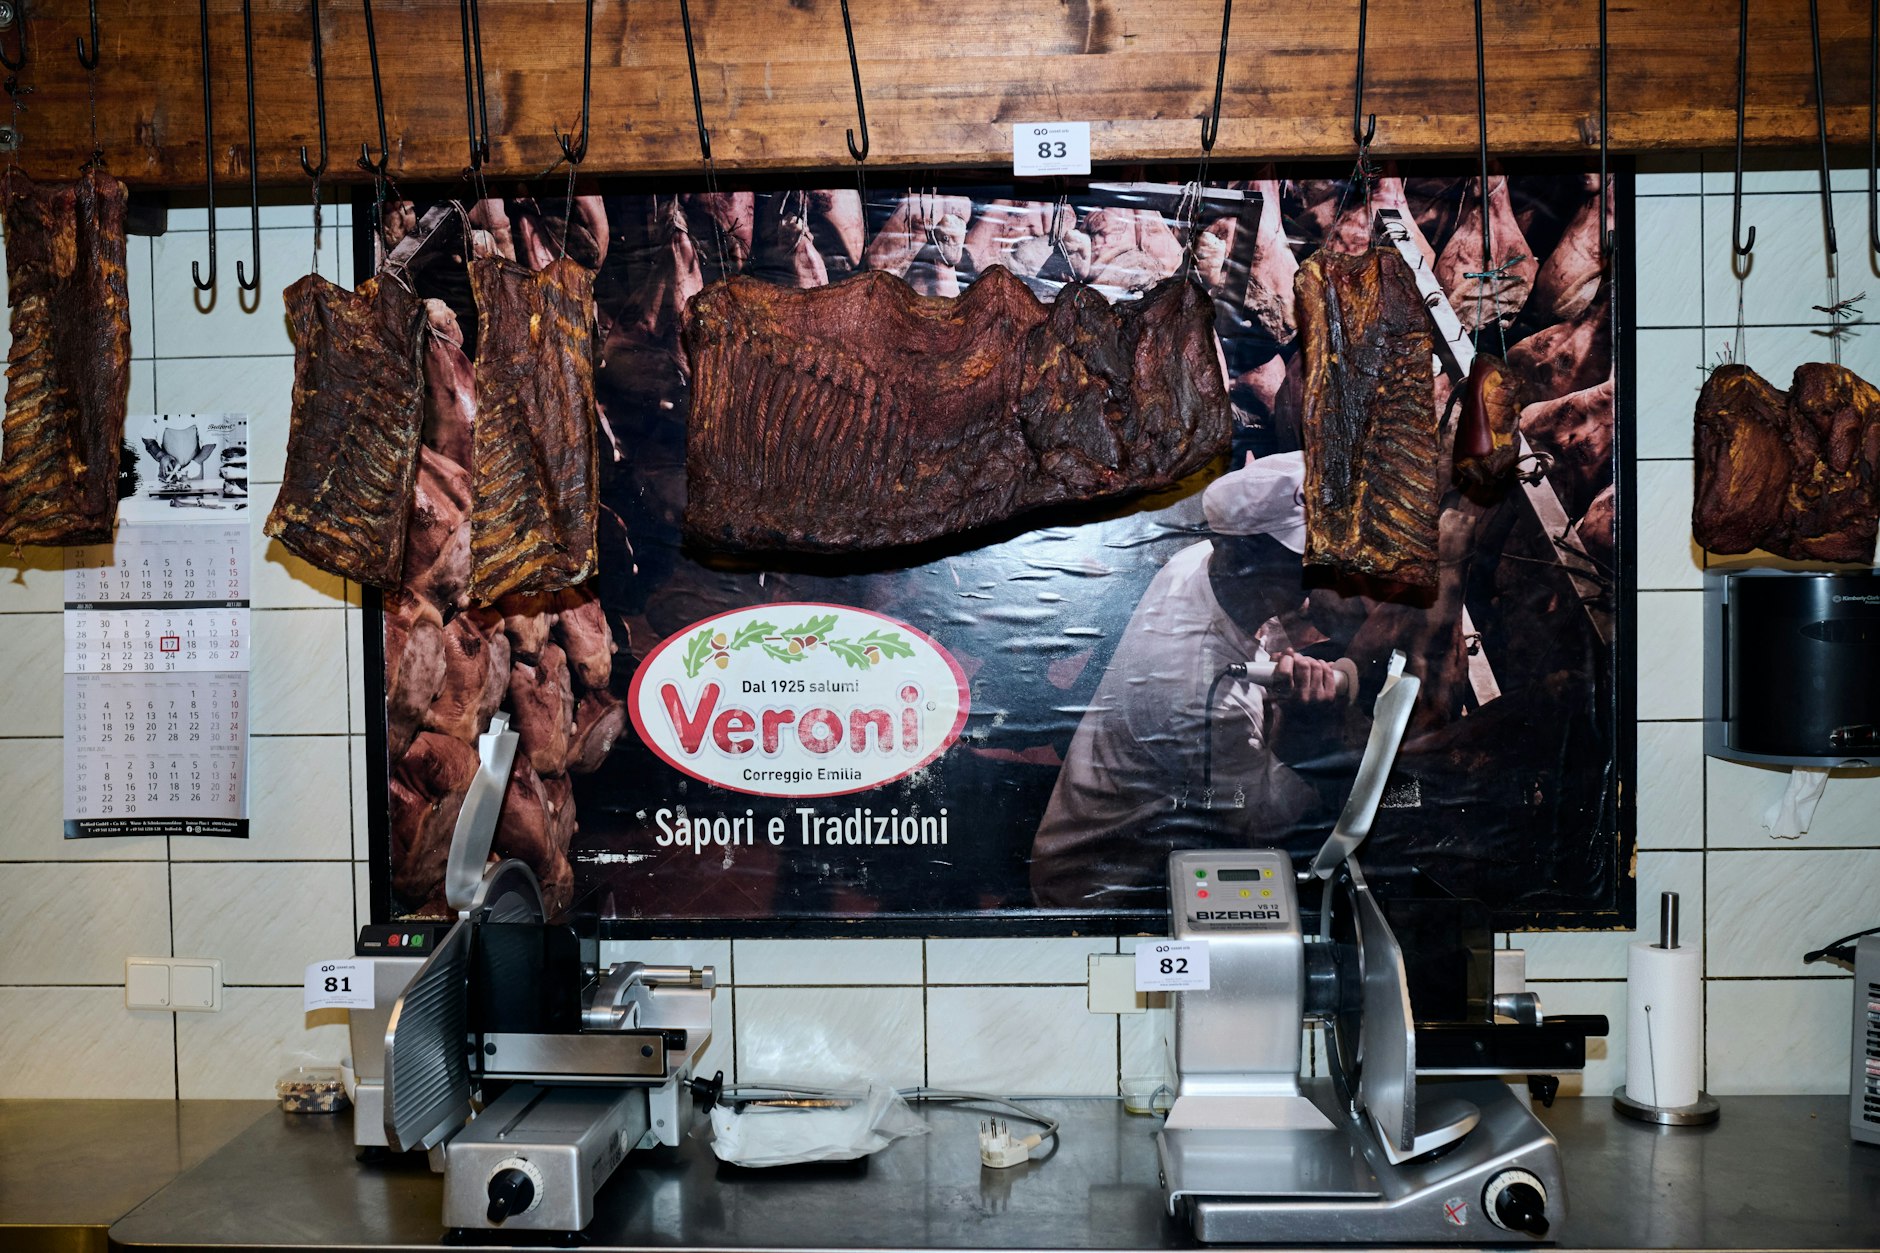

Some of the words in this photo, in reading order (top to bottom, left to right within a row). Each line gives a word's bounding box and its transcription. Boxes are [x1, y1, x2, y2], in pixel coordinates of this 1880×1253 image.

[1038, 142, 1067, 158] 83
[230, 547, 234, 555] 1
[122, 559, 127, 567] 3
[164, 558, 170, 567] 5
[186, 558, 192, 566] 6
[208, 558, 213, 566] 7
[230, 558, 236, 566] 8
[100, 570, 106, 578] 9
[120, 570, 130, 578] 10
[141, 570, 150, 578] 11
[163, 569, 172, 578] 12
[185, 569, 194, 577] 13
[207, 569, 216, 577] 14
[229, 568, 238, 577] 15
[99, 581, 109, 589] 16
[121, 581, 130, 589] 17
[142, 581, 152, 589] 18
[164, 580, 173, 588] 19
[184, 580, 195, 588] 20
[206, 579, 215, 588] 21
[228, 579, 238, 587] 22
[99, 592, 109, 600] 23
[120, 592, 130, 600] 24
[141, 591, 152, 599] 25
[163, 591, 173, 599] 26
[184, 591, 195, 599] 27
[206, 590, 217, 599] 28
[229, 590, 239, 598] 29
[100, 620, 110, 628] 30
[145, 619, 150, 627] 2
[167, 619, 171, 627] 3
[188, 619, 193, 627] 4
[210, 618, 215, 627] 5
[231, 618, 237, 626] 6
[103, 630, 108, 639] 7
[124, 630, 129, 639] 8
[145, 630, 150, 639] 9
[187, 630, 195, 638] 11
[209, 629, 218, 638] 12
[231, 629, 239, 637] 13
[102, 641, 111, 649] 14
[123, 641, 132, 649] 15
[144, 641, 154, 649] 16
[186, 640, 197, 648] 18
[209, 640, 219, 649] 19
[229, 640, 239, 648] 20
[101, 652, 110, 660] 21
[122, 652, 132, 660] 22
[144, 652, 154, 660] 23
[186, 651, 197, 659] 25
[209, 651, 219, 659] 26
[230, 651, 239, 659] 27
[101, 663, 112, 671] 28
[123, 663, 133, 671] 29
[166, 662, 175, 670] 31
[742, 680, 765, 693] Dal
[772, 680, 804, 693] 1925
[809, 680, 859, 692] salumi
[191, 690, 195, 698] 1
[212, 690, 217, 698] 2
[232, 690, 237, 698] 3
[104, 701, 110, 709] 4
[126, 701, 132, 709] 5
[148, 701, 153, 709] 6
[170, 701, 174, 709] 7
[191, 701, 196, 709] 8
[212, 700, 218, 709] 9
[231, 700, 239, 709] 10
[102, 712, 111, 720] 11
[125, 712, 134, 720] 12
[147, 712, 156, 720] 13
[190, 711, 199, 719] 15
[211, 711, 220, 720] 16
[231, 711, 239, 719] 17
[659, 682, 919, 754] Veroni
[103, 723, 113, 731] 18
[125, 723, 135, 731] 19
[146, 722, 157, 731] 20
[168, 722, 177, 731] 21
[189, 722, 199, 730] 22
[210, 722, 220, 731] 23
[230, 722, 238, 730] 24
[101, 734, 113, 742] 25
[124, 733, 135, 742] 26
[146, 733, 157, 742] 27
[168, 733, 179, 741] 28
[189, 733, 200, 741] 29
[210, 733, 221, 741] 30
[230, 733, 237, 741] 31
[105, 762, 109, 770] 1
[127, 761, 133, 770] 2
[150, 761, 155, 769] 3
[171, 761, 176, 769] 4
[192, 761, 198, 769] 5
[212, 761, 218, 769] 6
[231, 761, 236, 769] 7
[104, 773, 110, 781] 8
[127, 772, 133, 780] 9
[148, 772, 158, 780] 10
[191, 772, 200, 780] 12
[212, 771, 220, 780] 13
[230, 772, 237, 780] 14
[743, 768, 813, 783] Correggio
[818, 768, 862, 781] Emilia
[103, 783, 113, 791] 15
[126, 783, 136, 791] 16
[148, 783, 158, 791] 17
[170, 782, 180, 791] 18
[191, 782, 200, 791] 19
[211, 782, 220, 791] 20
[229, 783, 236, 792] 21
[102, 794, 113, 803] 22
[125, 794, 136, 802] 23
[148, 793, 158, 801] 24
[169, 793, 180, 801] 25
[190, 793, 201, 801] 26
[211, 793, 220, 802] 27
[228, 794, 236, 803] 28
[102, 805, 113, 813] 29
[125, 804, 136, 813] 30
[655, 808, 753, 854] Sapori
[768, 817, 784, 845] e
[796, 808, 947, 845] Tradizioni
[1196, 911, 1280, 920] BIZERBA
[1160, 958, 1188, 974] 82
[324, 976, 352, 992] 81
